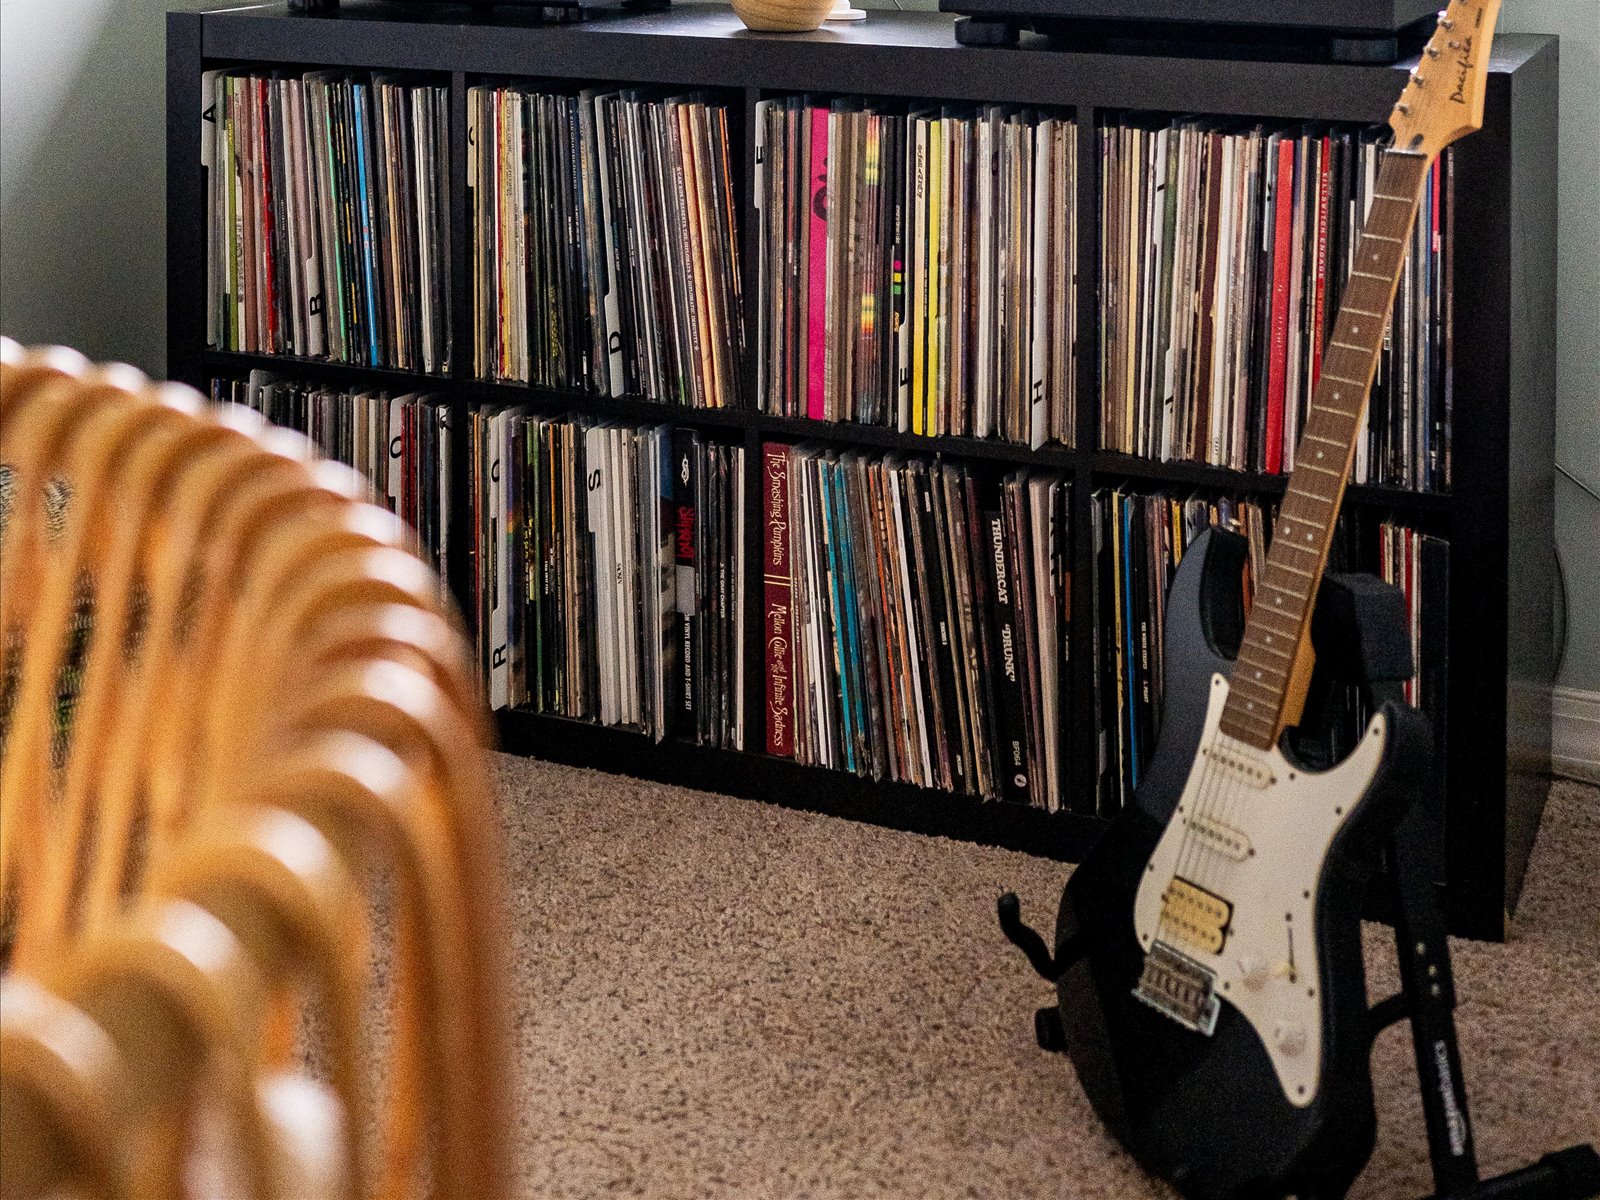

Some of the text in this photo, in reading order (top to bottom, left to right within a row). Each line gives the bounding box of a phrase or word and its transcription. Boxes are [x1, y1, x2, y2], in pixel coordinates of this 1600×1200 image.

[609, 331, 621, 355] D
[1033, 379, 1042, 405] H
[767, 451, 786, 468] The
[588, 469, 601, 492] S
[767, 466, 786, 518] Smashing
[768, 519, 787, 566] Pumpkins
[991, 518, 1008, 604] THUNDERCAT
[768, 603, 787, 634] Mellon
[493, 644, 506, 670] R
[768, 636, 787, 659] Collie
[772, 674, 787, 705] Infinite
[769, 701, 788, 747] Sadness
